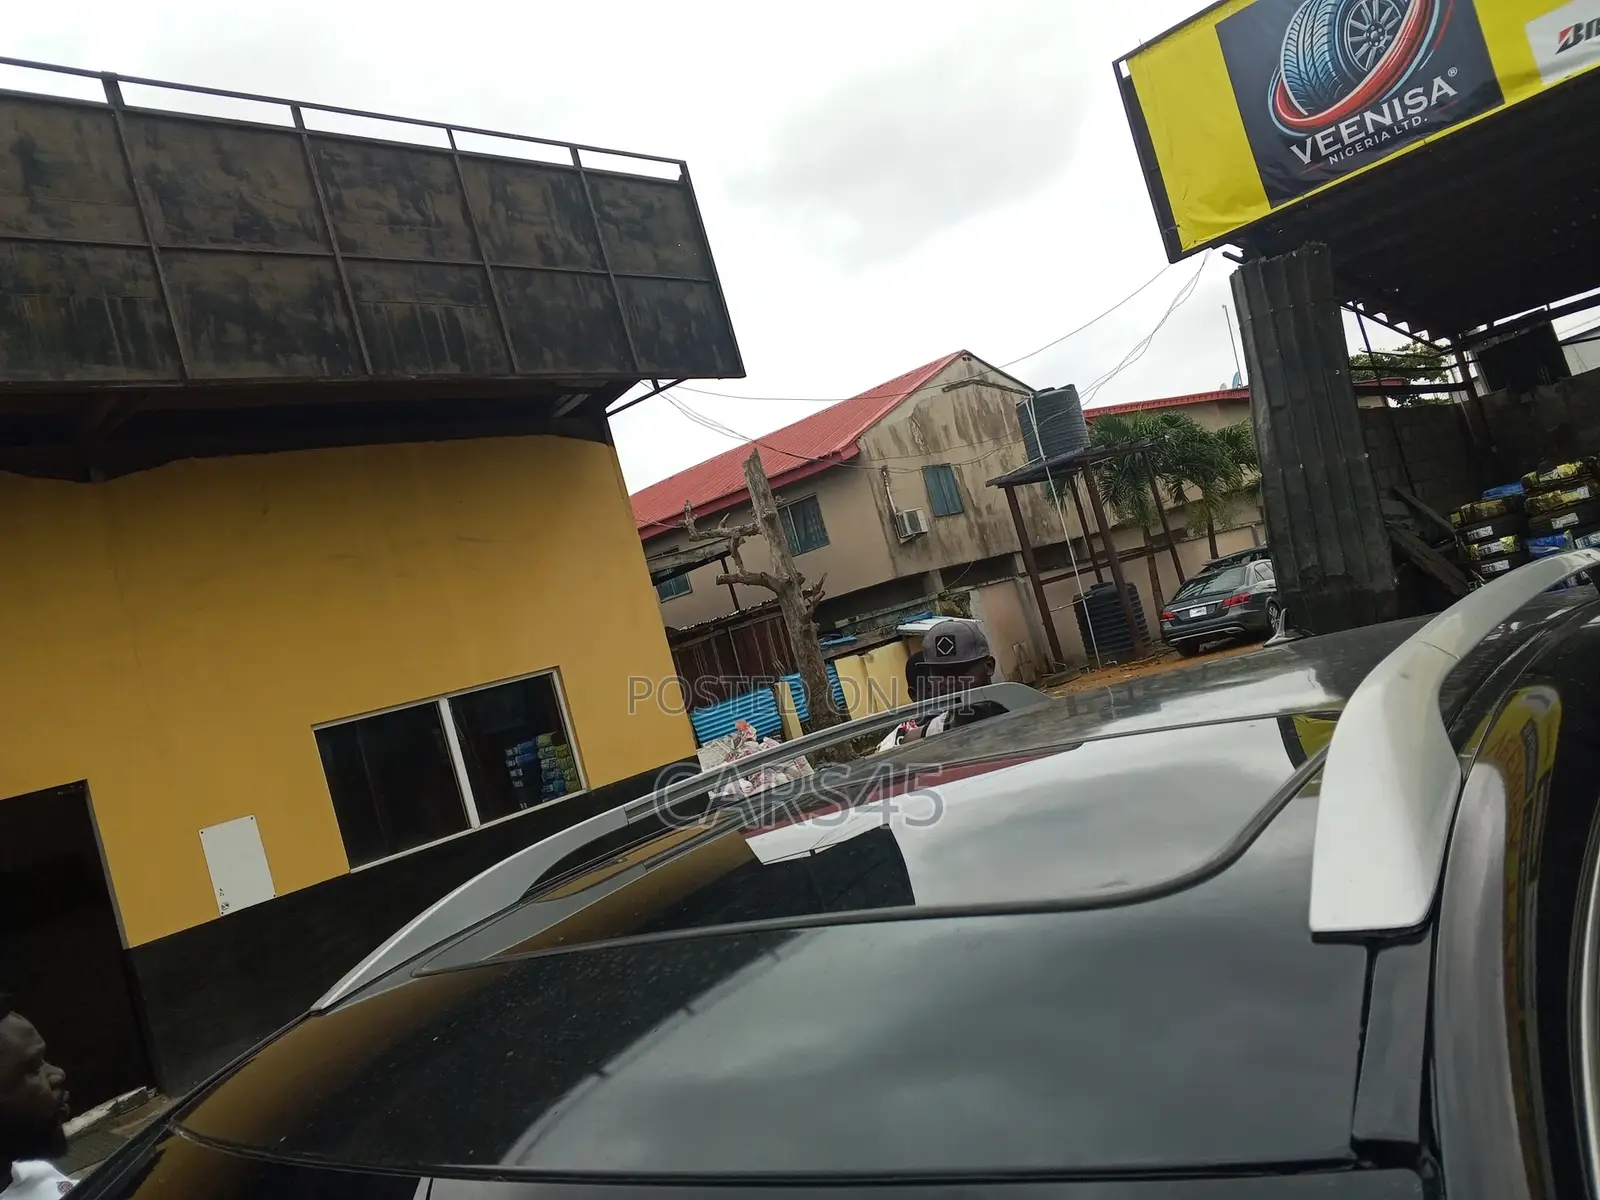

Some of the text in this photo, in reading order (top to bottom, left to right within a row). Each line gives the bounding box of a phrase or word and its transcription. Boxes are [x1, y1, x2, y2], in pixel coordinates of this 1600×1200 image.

[1289, 75, 1458, 165] VEENISA
[1328, 115, 1428, 165] NIGERIA LTD.
